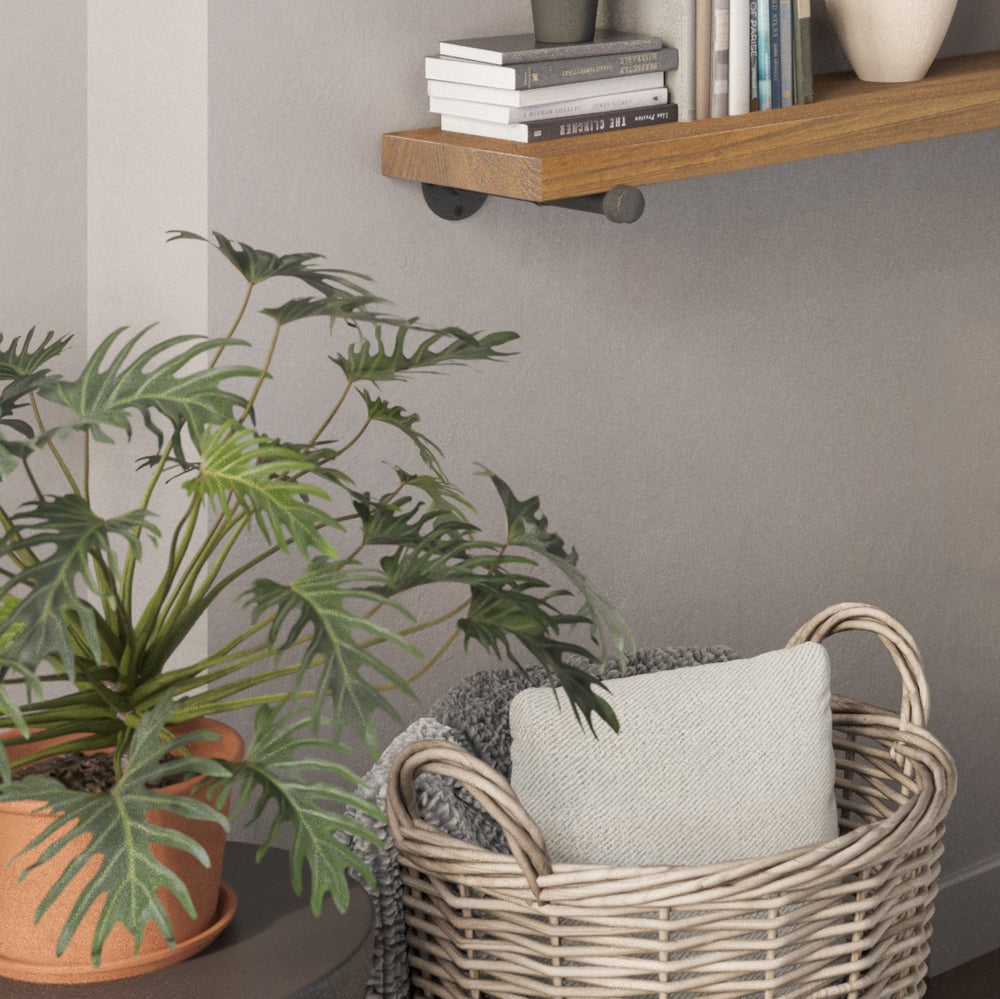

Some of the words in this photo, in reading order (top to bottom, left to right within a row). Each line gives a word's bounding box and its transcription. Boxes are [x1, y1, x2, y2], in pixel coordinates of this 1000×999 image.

[750, 2, 757, 16] OF
[559, 119, 605, 136] CLINCHER
[609, 116, 626, 127] THE
